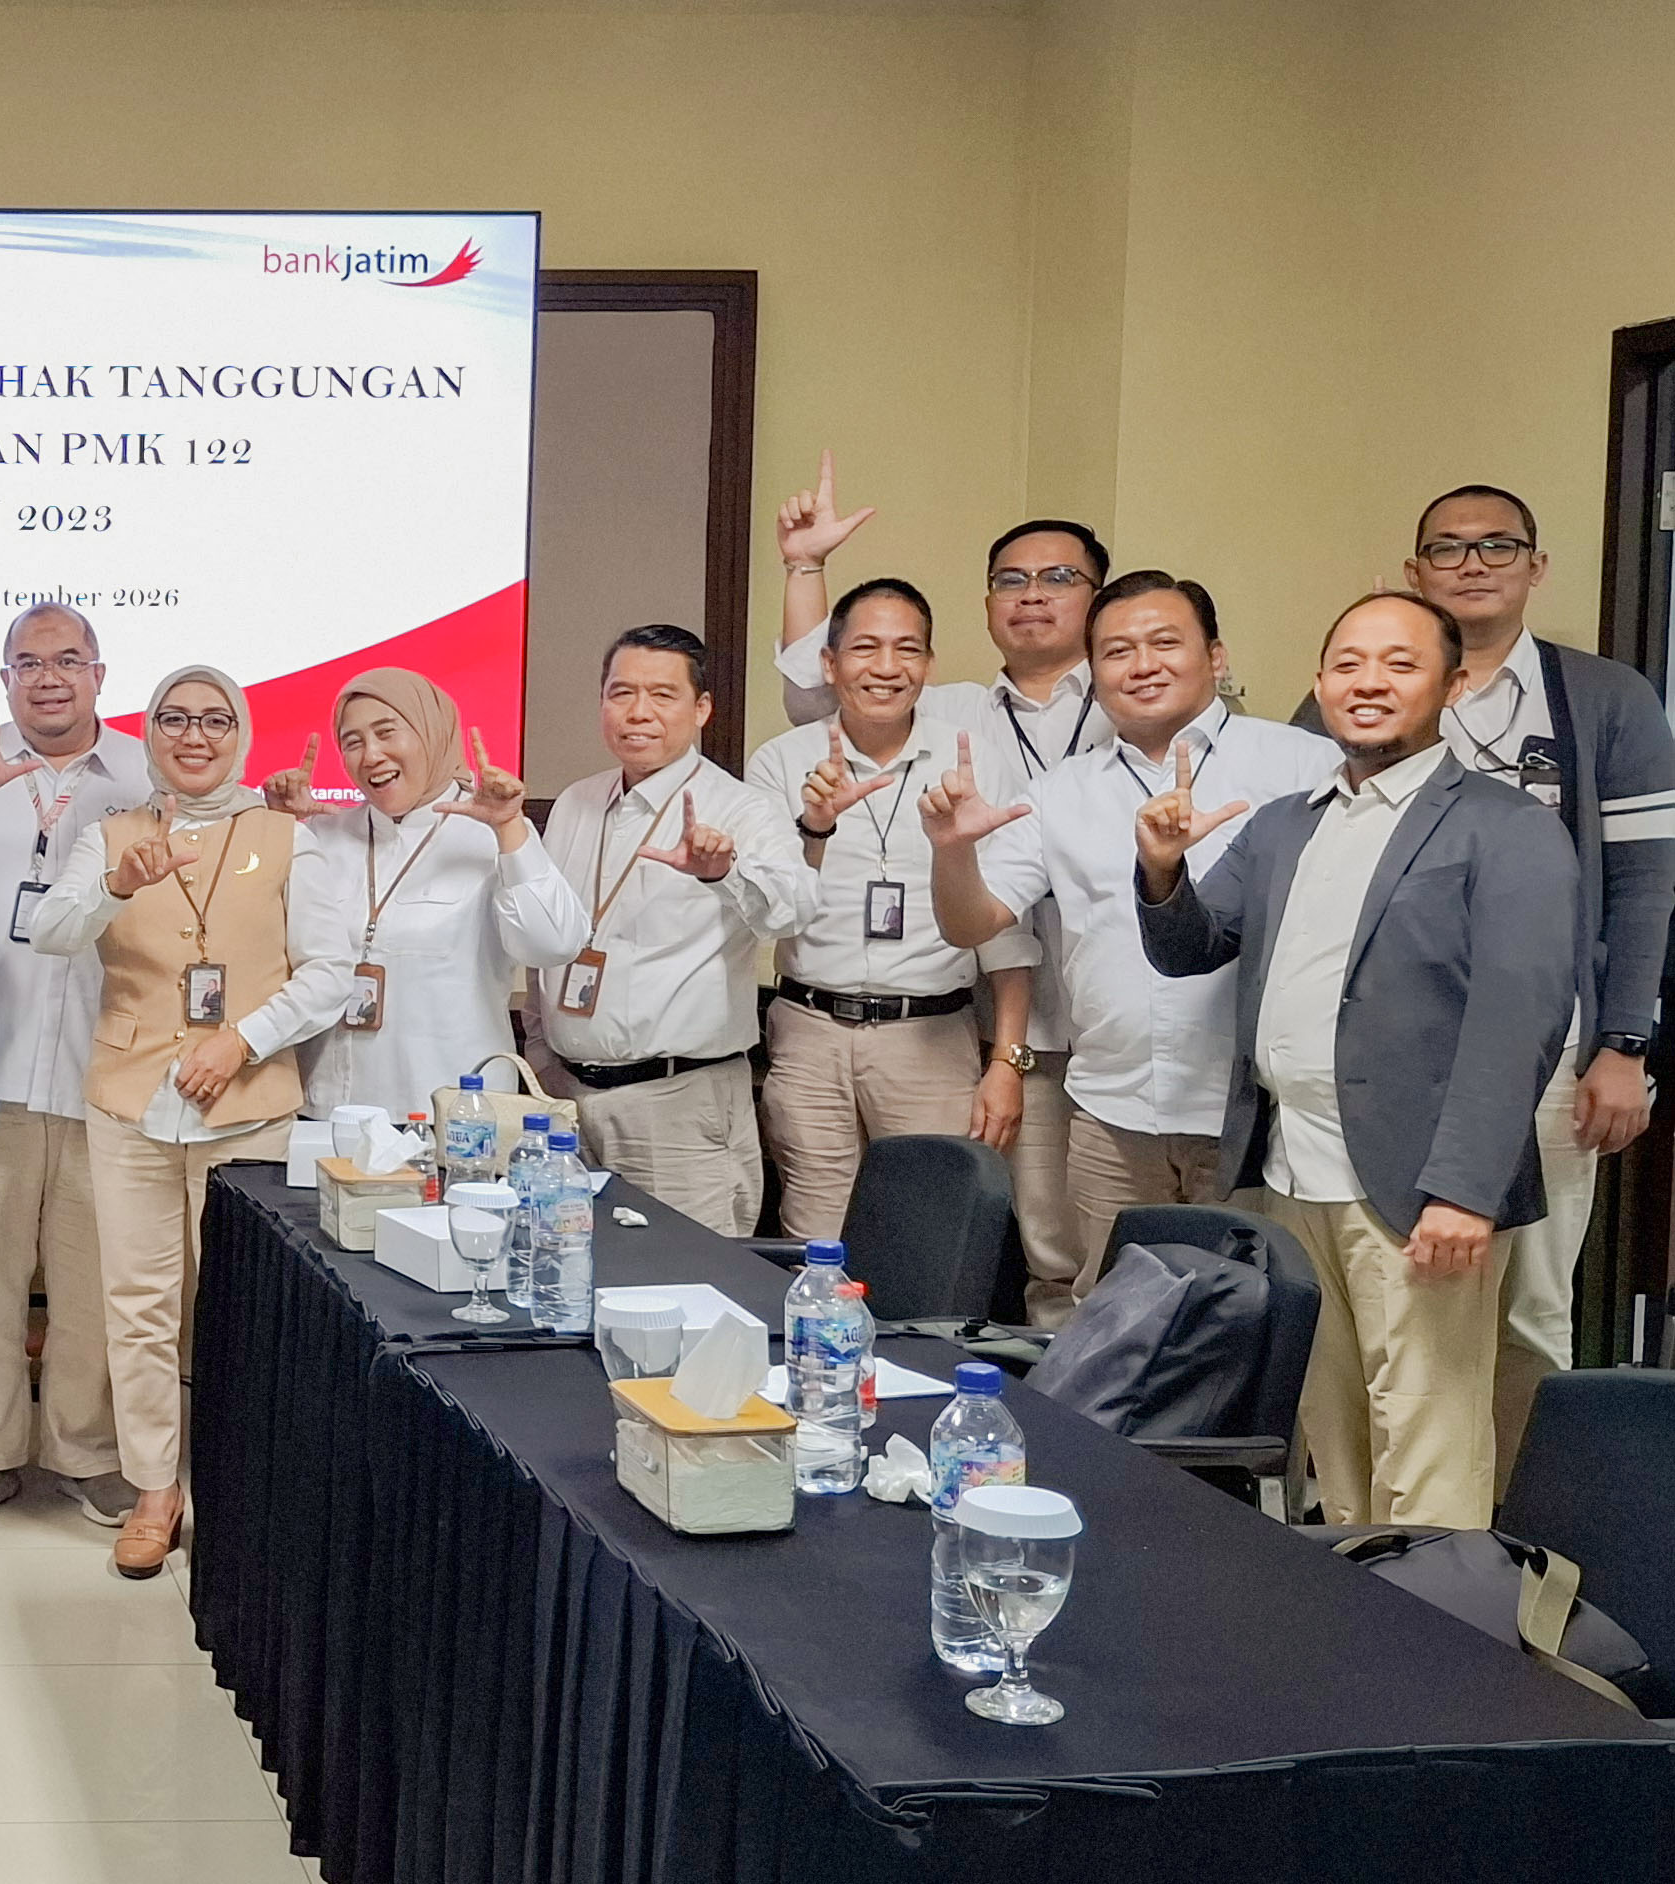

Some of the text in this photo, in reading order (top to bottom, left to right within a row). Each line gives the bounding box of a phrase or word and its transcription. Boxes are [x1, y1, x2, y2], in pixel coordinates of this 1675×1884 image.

[263, 244, 428, 281] bankjatim
[108, 365, 466, 399] TANGGUNGAN
[62, 432, 165, 465] PMK
[187, 438, 252, 465] 122
[17, 505, 113, 532] 2023
[113, 588, 180, 607] 2026
